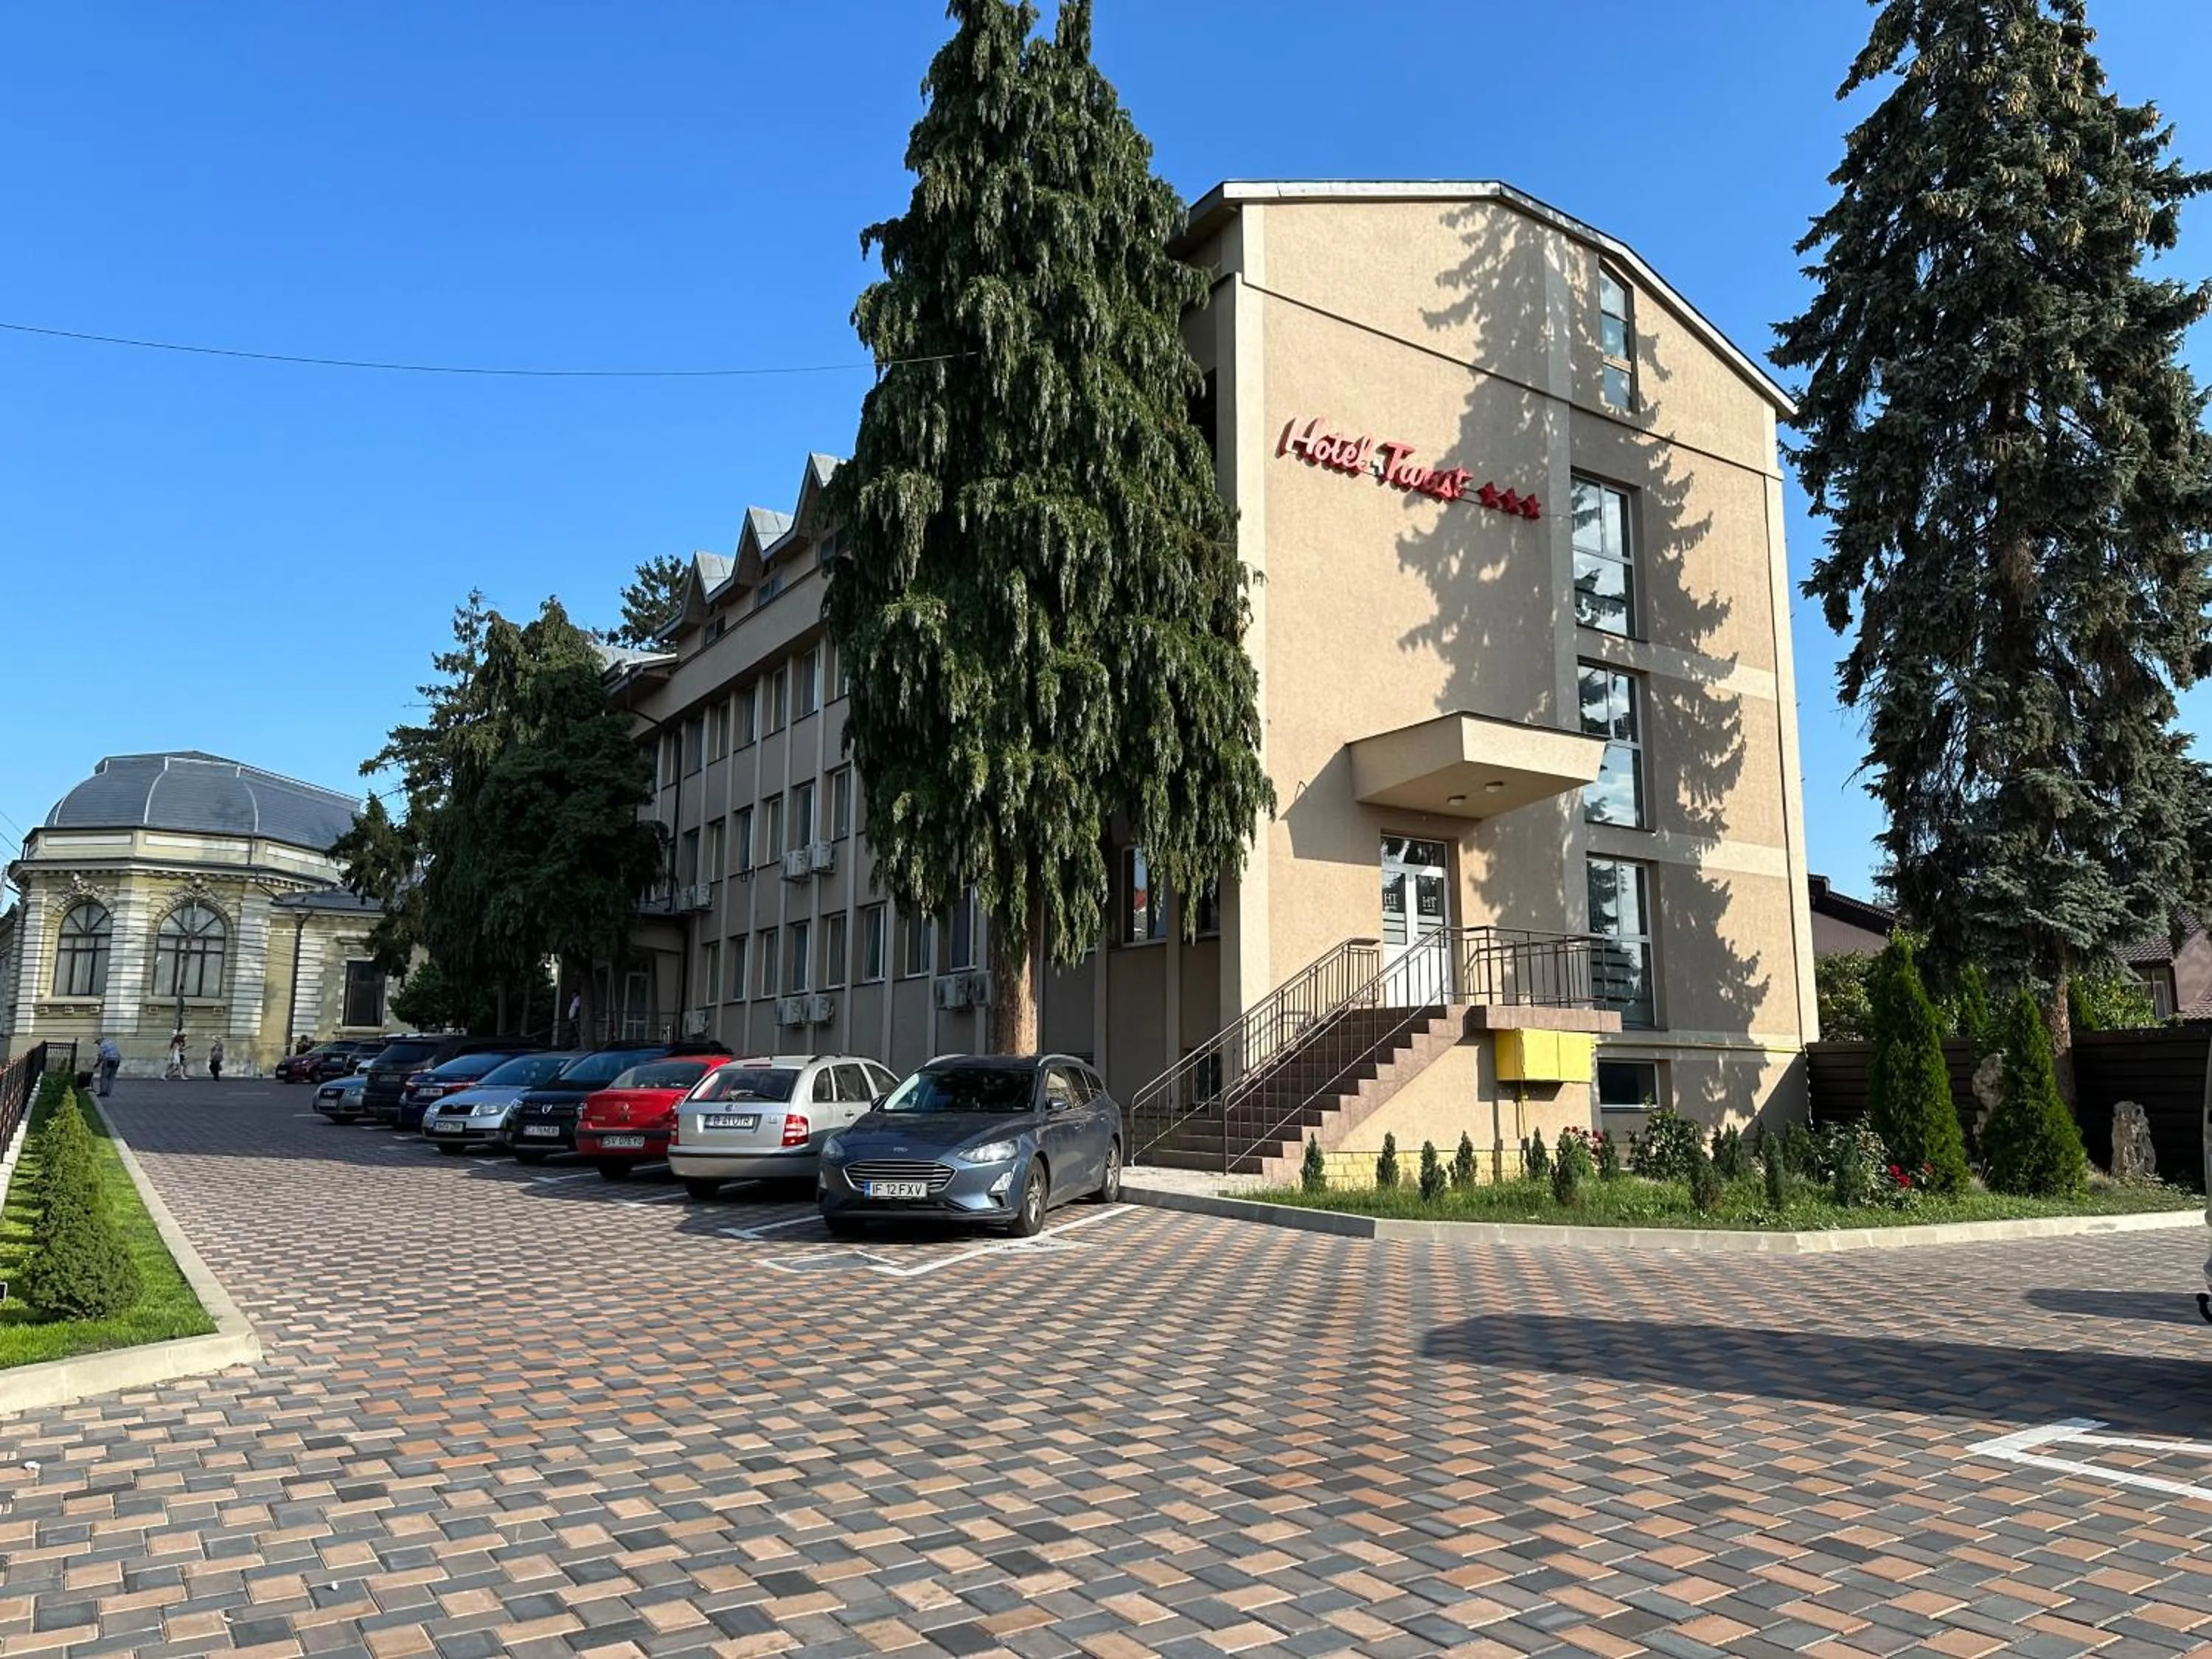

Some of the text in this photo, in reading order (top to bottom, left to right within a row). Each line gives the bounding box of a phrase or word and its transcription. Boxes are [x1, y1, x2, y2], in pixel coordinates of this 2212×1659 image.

[1276, 417, 1374, 473] Hotel
[872, 1184, 922, 1195] IF 12 FXV
